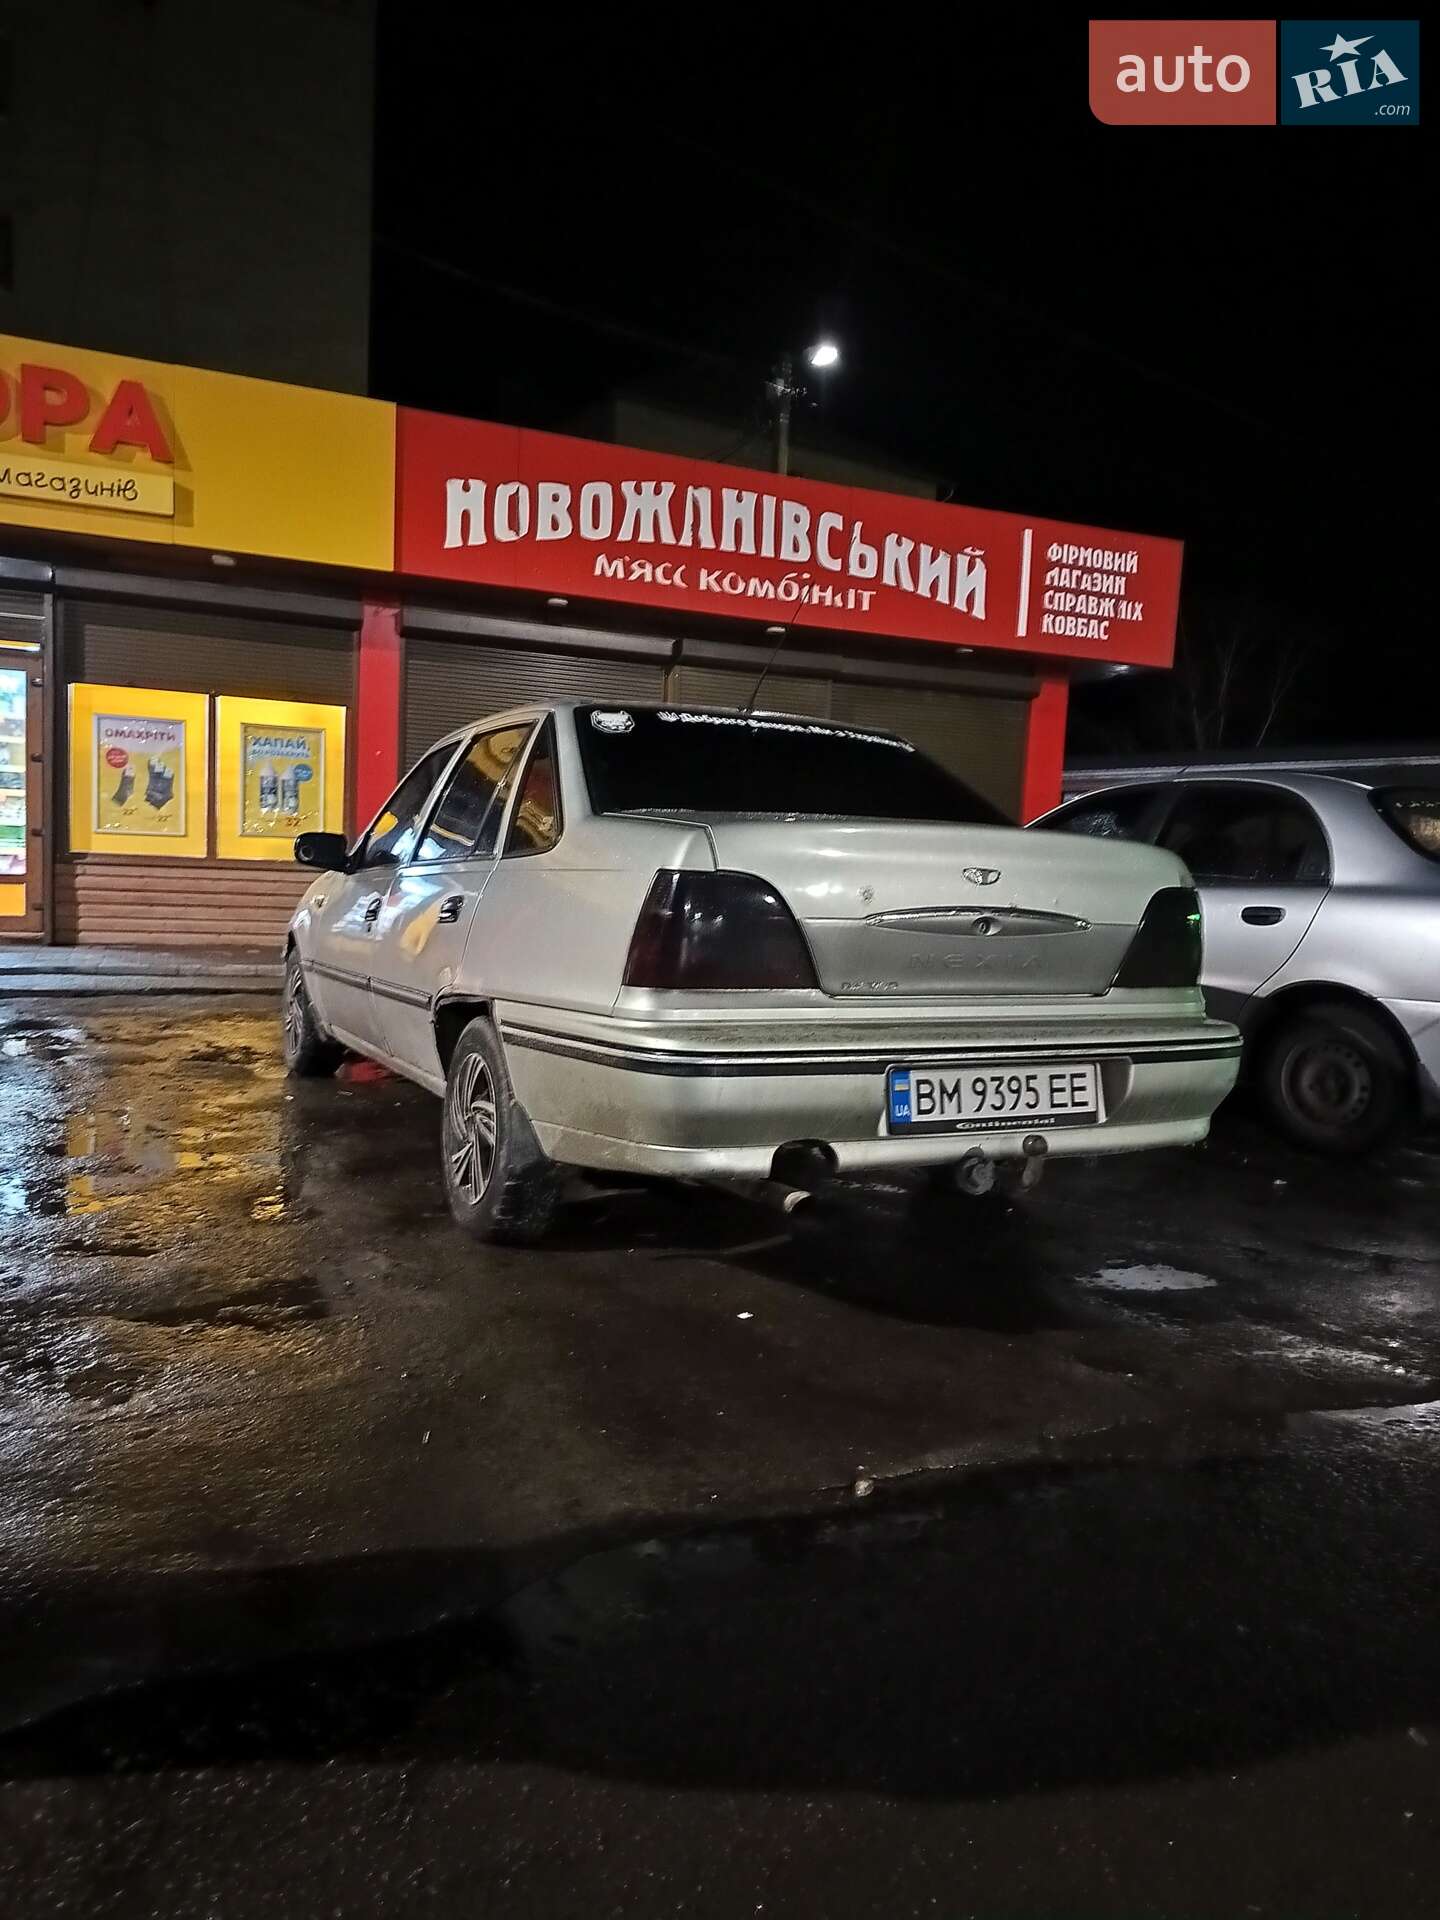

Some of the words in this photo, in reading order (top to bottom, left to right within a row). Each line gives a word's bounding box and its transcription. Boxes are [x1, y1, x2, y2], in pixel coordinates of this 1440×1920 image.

[0, 363, 175, 464] РА
[443, 478, 988, 621] НОВОЖАНІВСЬКИЙ
[1046, 542, 1139, 574] ФІРМОВИЙ
[1043, 567, 1127, 596] МАГАЗИН
[1041, 612, 1110, 641] КОВБАС
[916, 1078, 963, 1116] BM
[971, 1074, 1041, 1113] 9395
[1049, 1072, 1090, 1109] EE
[895, 1104, 911, 1117] UA
